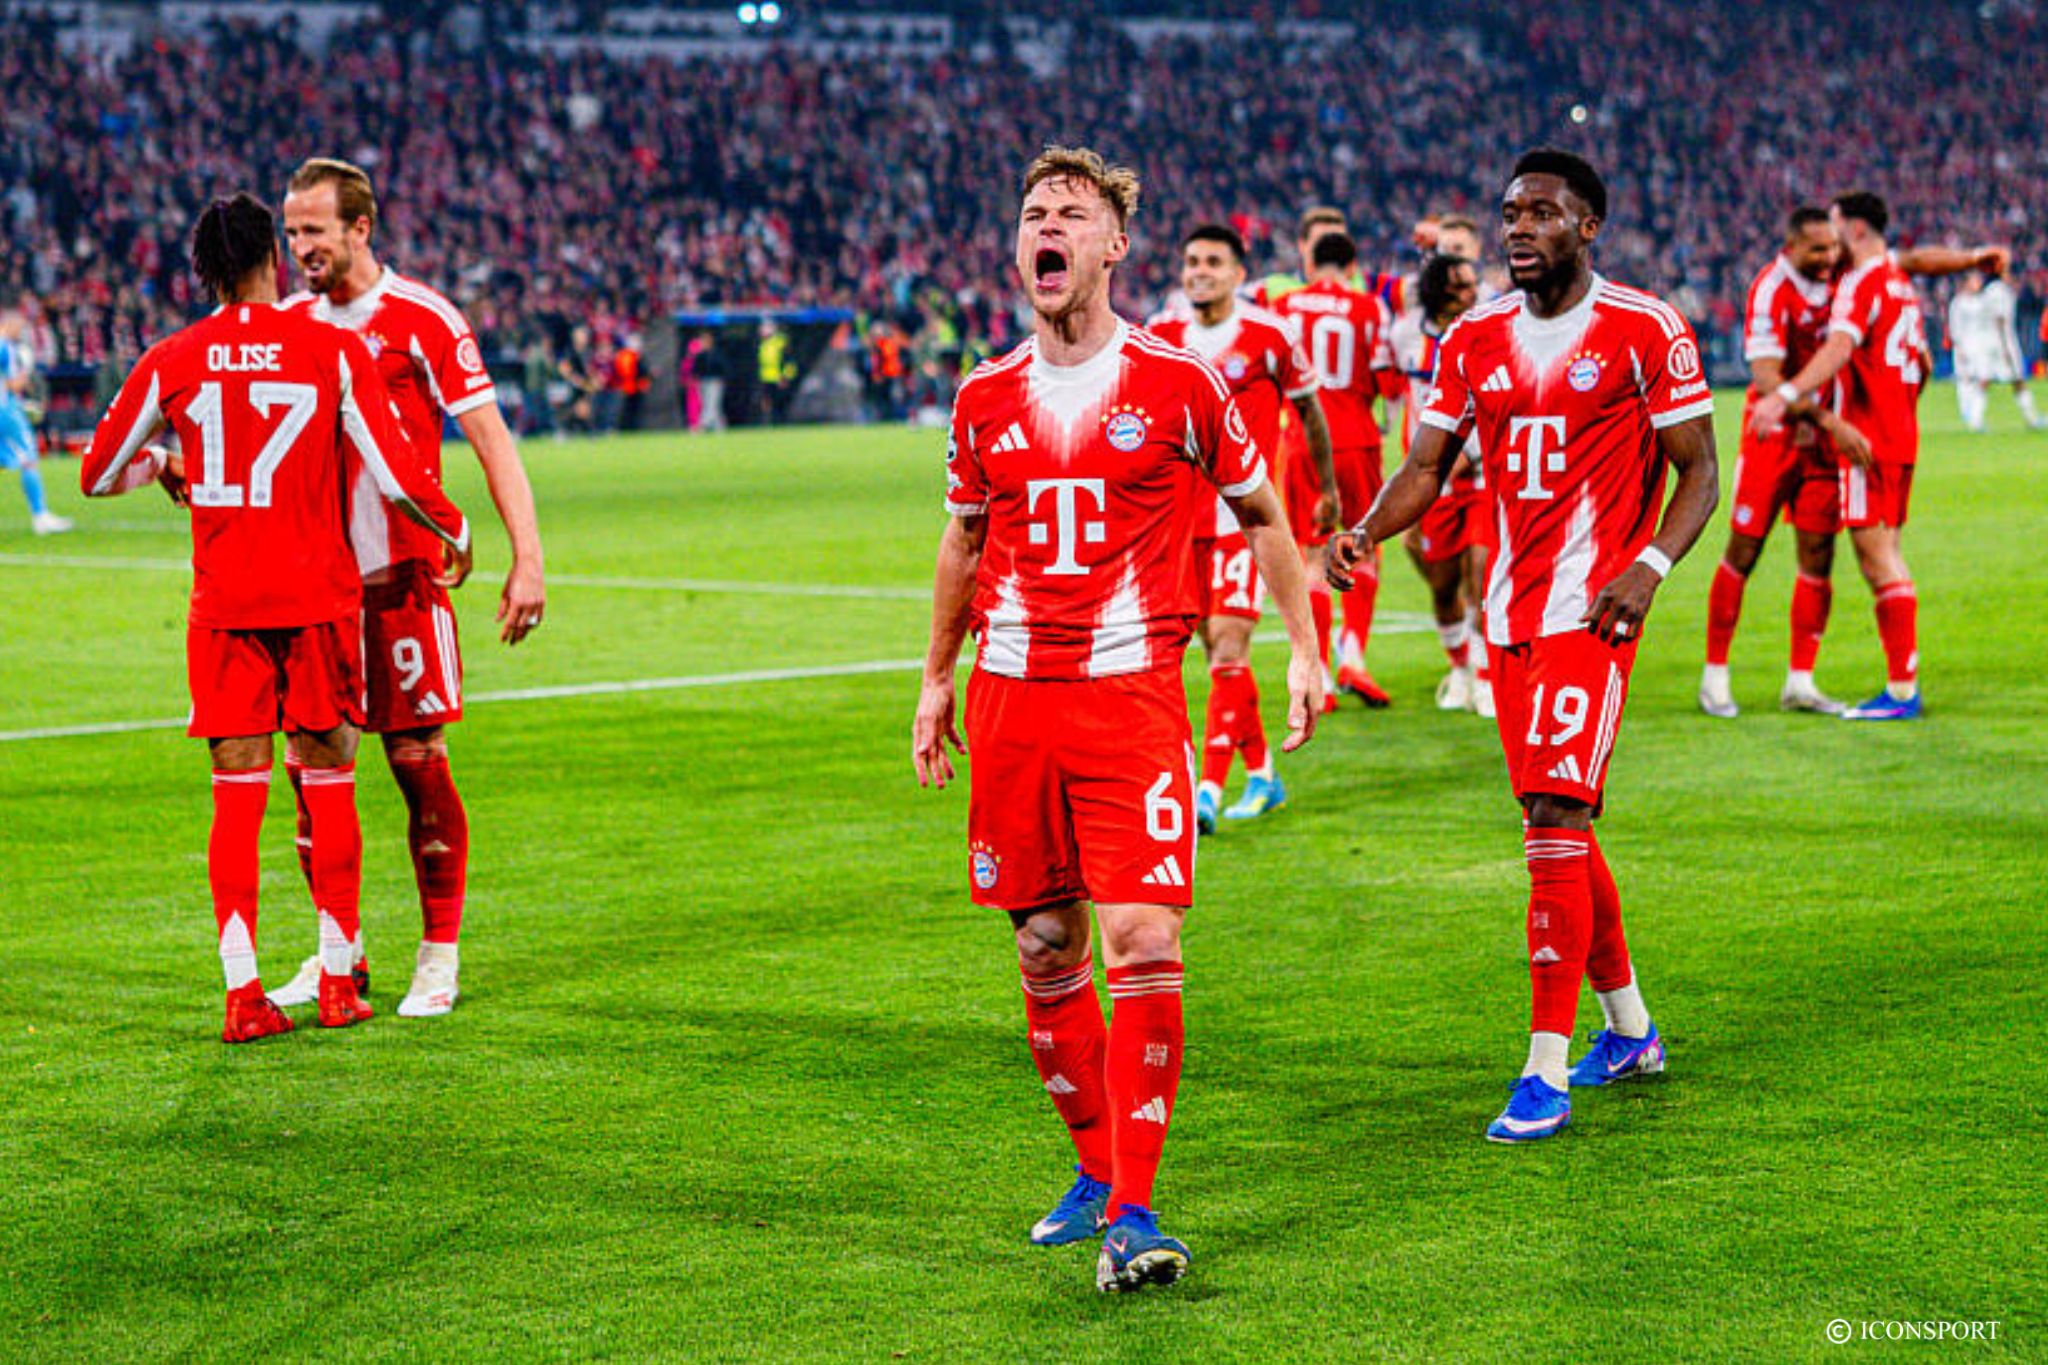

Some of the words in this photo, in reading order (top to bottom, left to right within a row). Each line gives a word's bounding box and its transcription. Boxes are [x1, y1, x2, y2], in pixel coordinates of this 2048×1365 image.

[207, 343, 283, 372] OLISE
[185, 381, 318, 508] 17
[1507, 415, 1567, 499] T
[1026, 478, 1105, 575] T
[1211, 547, 1252, 593] 14
[392, 636, 424, 692] 9
[1526, 683, 1590, 746] 19
[1144, 771, 1183, 841] 6
